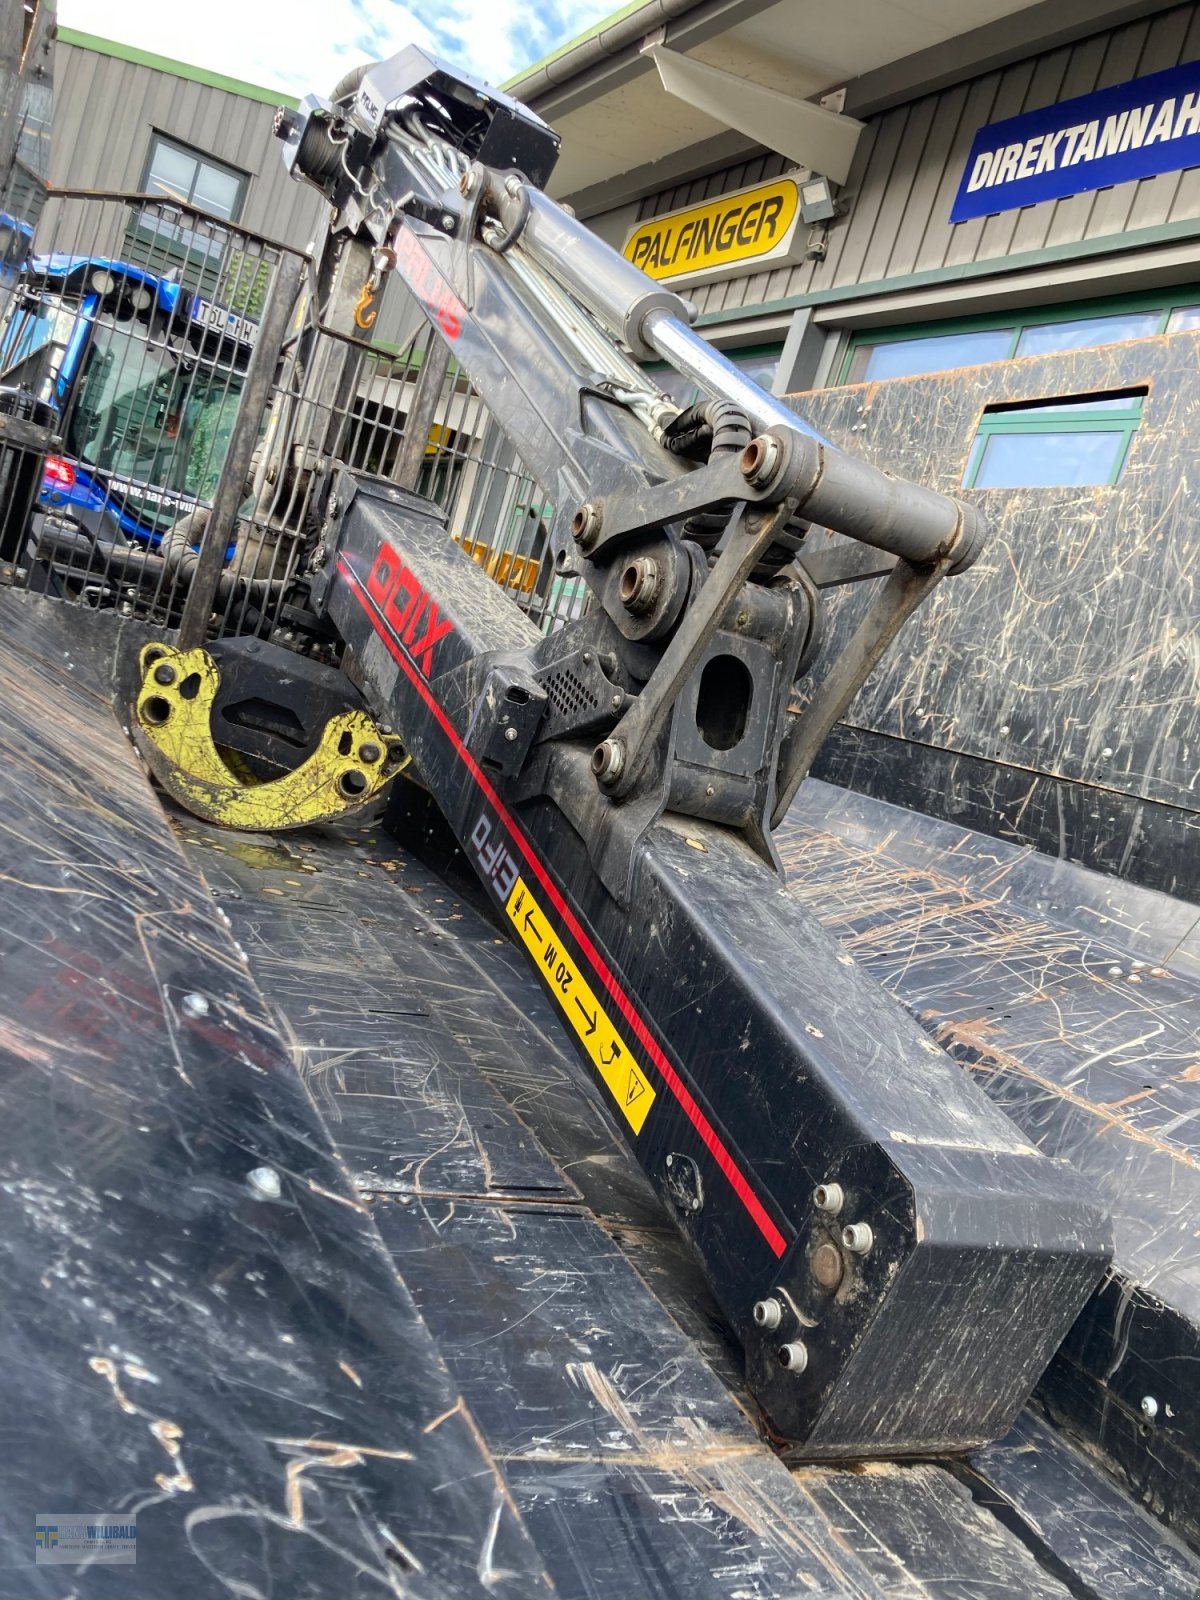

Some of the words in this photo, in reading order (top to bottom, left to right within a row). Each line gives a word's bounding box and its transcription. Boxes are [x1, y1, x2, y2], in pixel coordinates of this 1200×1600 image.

[966, 92, 1200, 193] DIREKTANNAH
[631, 195, 784, 271] PALFINGER
[366, 539, 456, 680] X100
[543, 943, 557, 969] M
[555, 962, 574, 993] 20
